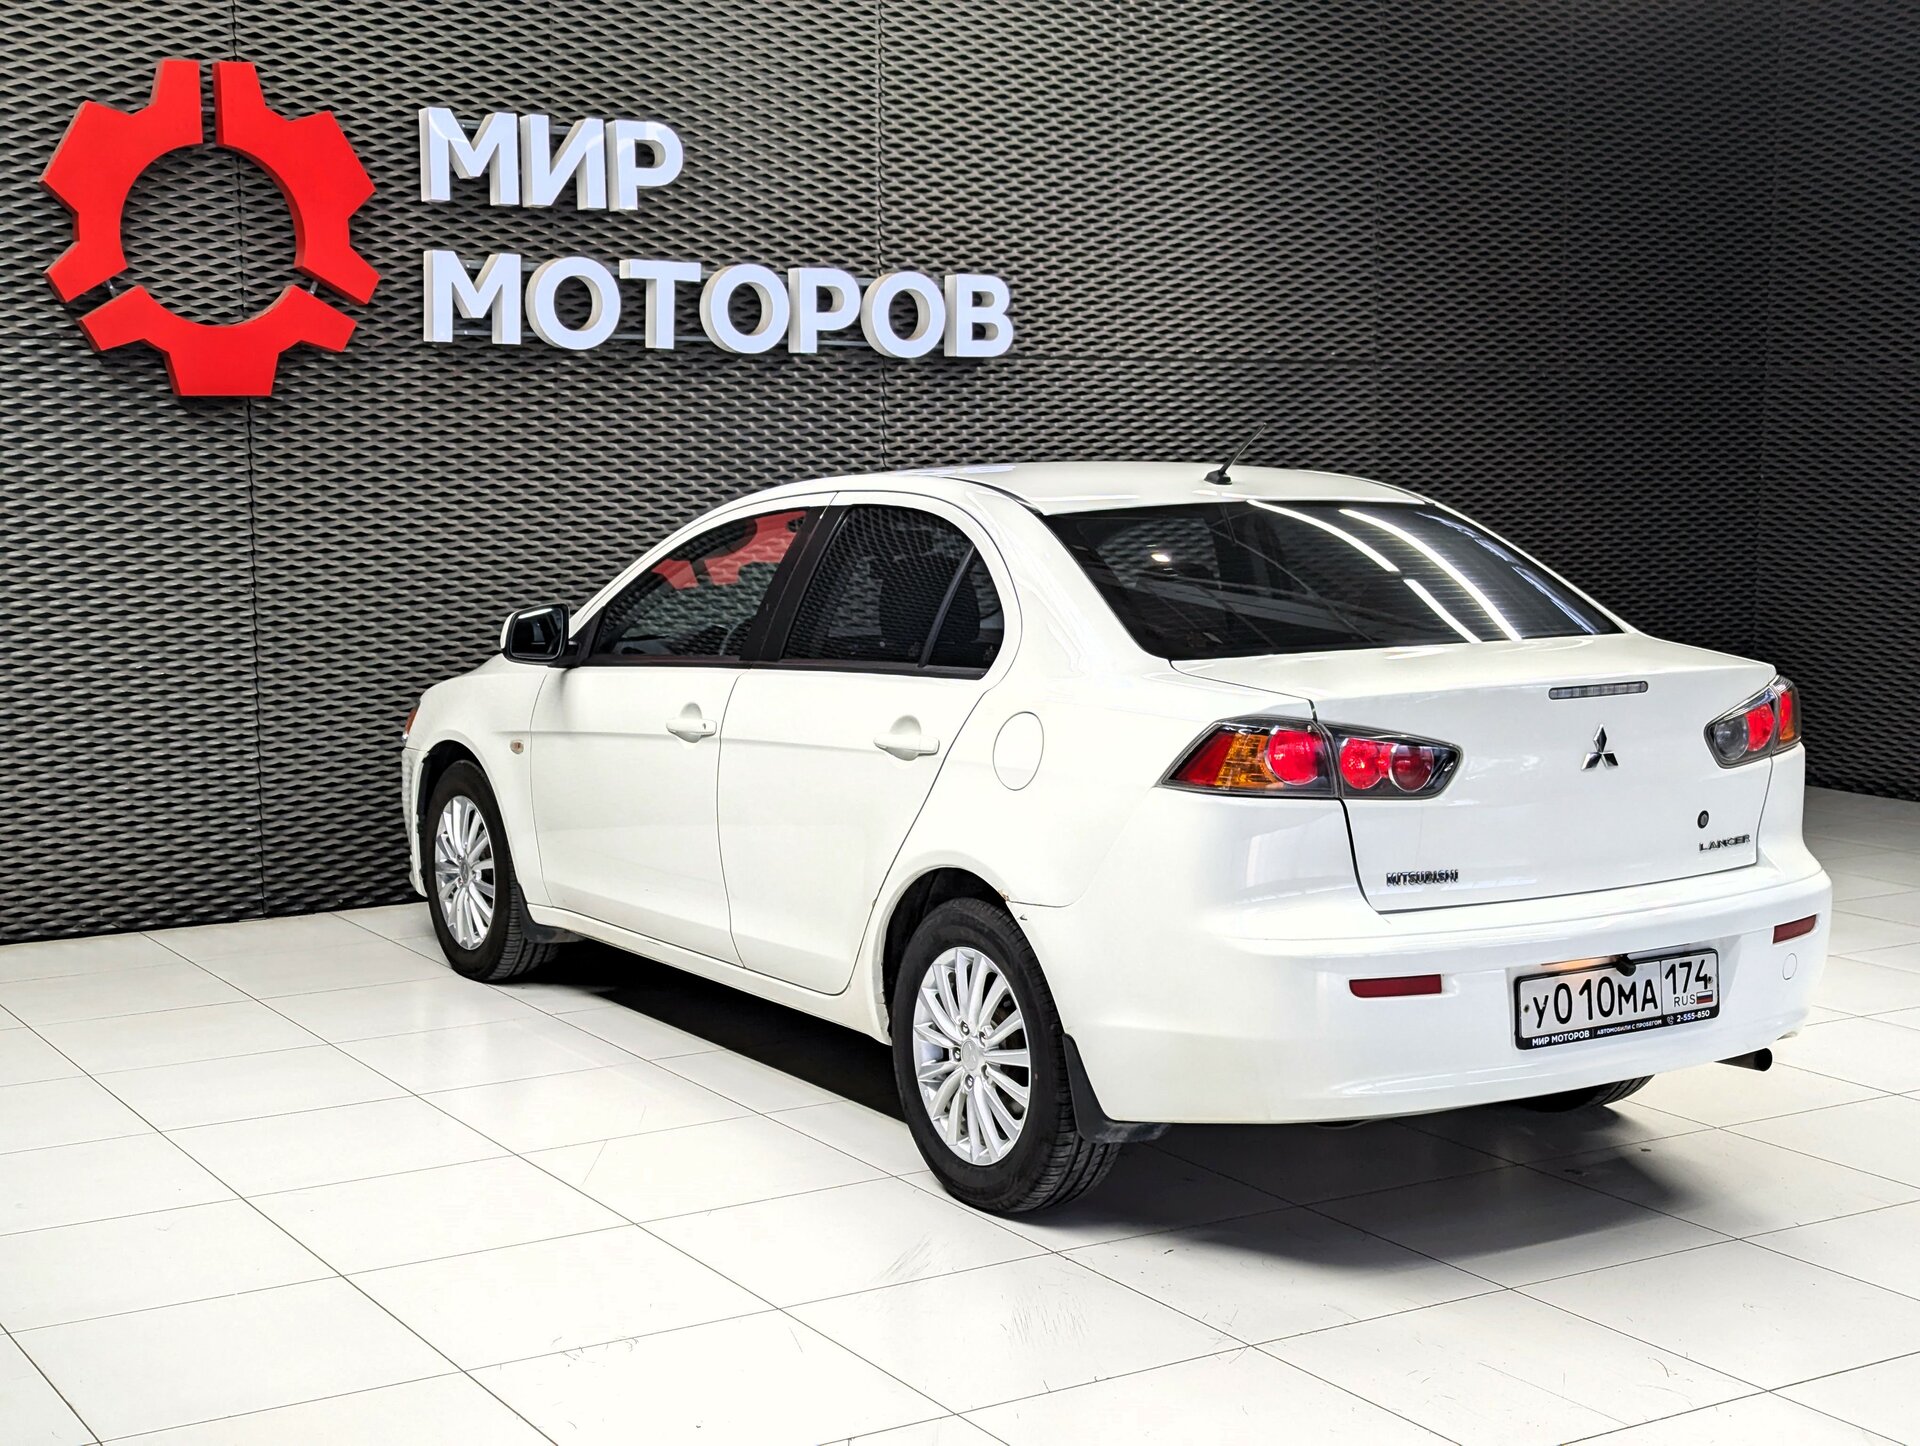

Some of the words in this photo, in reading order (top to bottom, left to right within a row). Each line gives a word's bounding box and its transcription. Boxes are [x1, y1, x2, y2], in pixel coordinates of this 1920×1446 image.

[418, 106, 684, 212] МИР
[422, 249, 1014, 358] МОТОРОВ
[1699, 833, 1751, 852] LANCER
[1386, 869, 1459, 886] MITSUBISHI
[1664, 959, 1708, 995] 174
[1673, 993, 1696, 1008] RUS
[1532, 1036, 1550, 1047] МИР
[1551, 1030, 1590, 1044] МОТОРОВ
[1596, 1024, 1632, 1036] АВТОМОБИЛИ
[1636, 1019, 1662, 1029] ПРОБЕГОМ
[1676, 1010, 1711, 1023] 2-555-850
